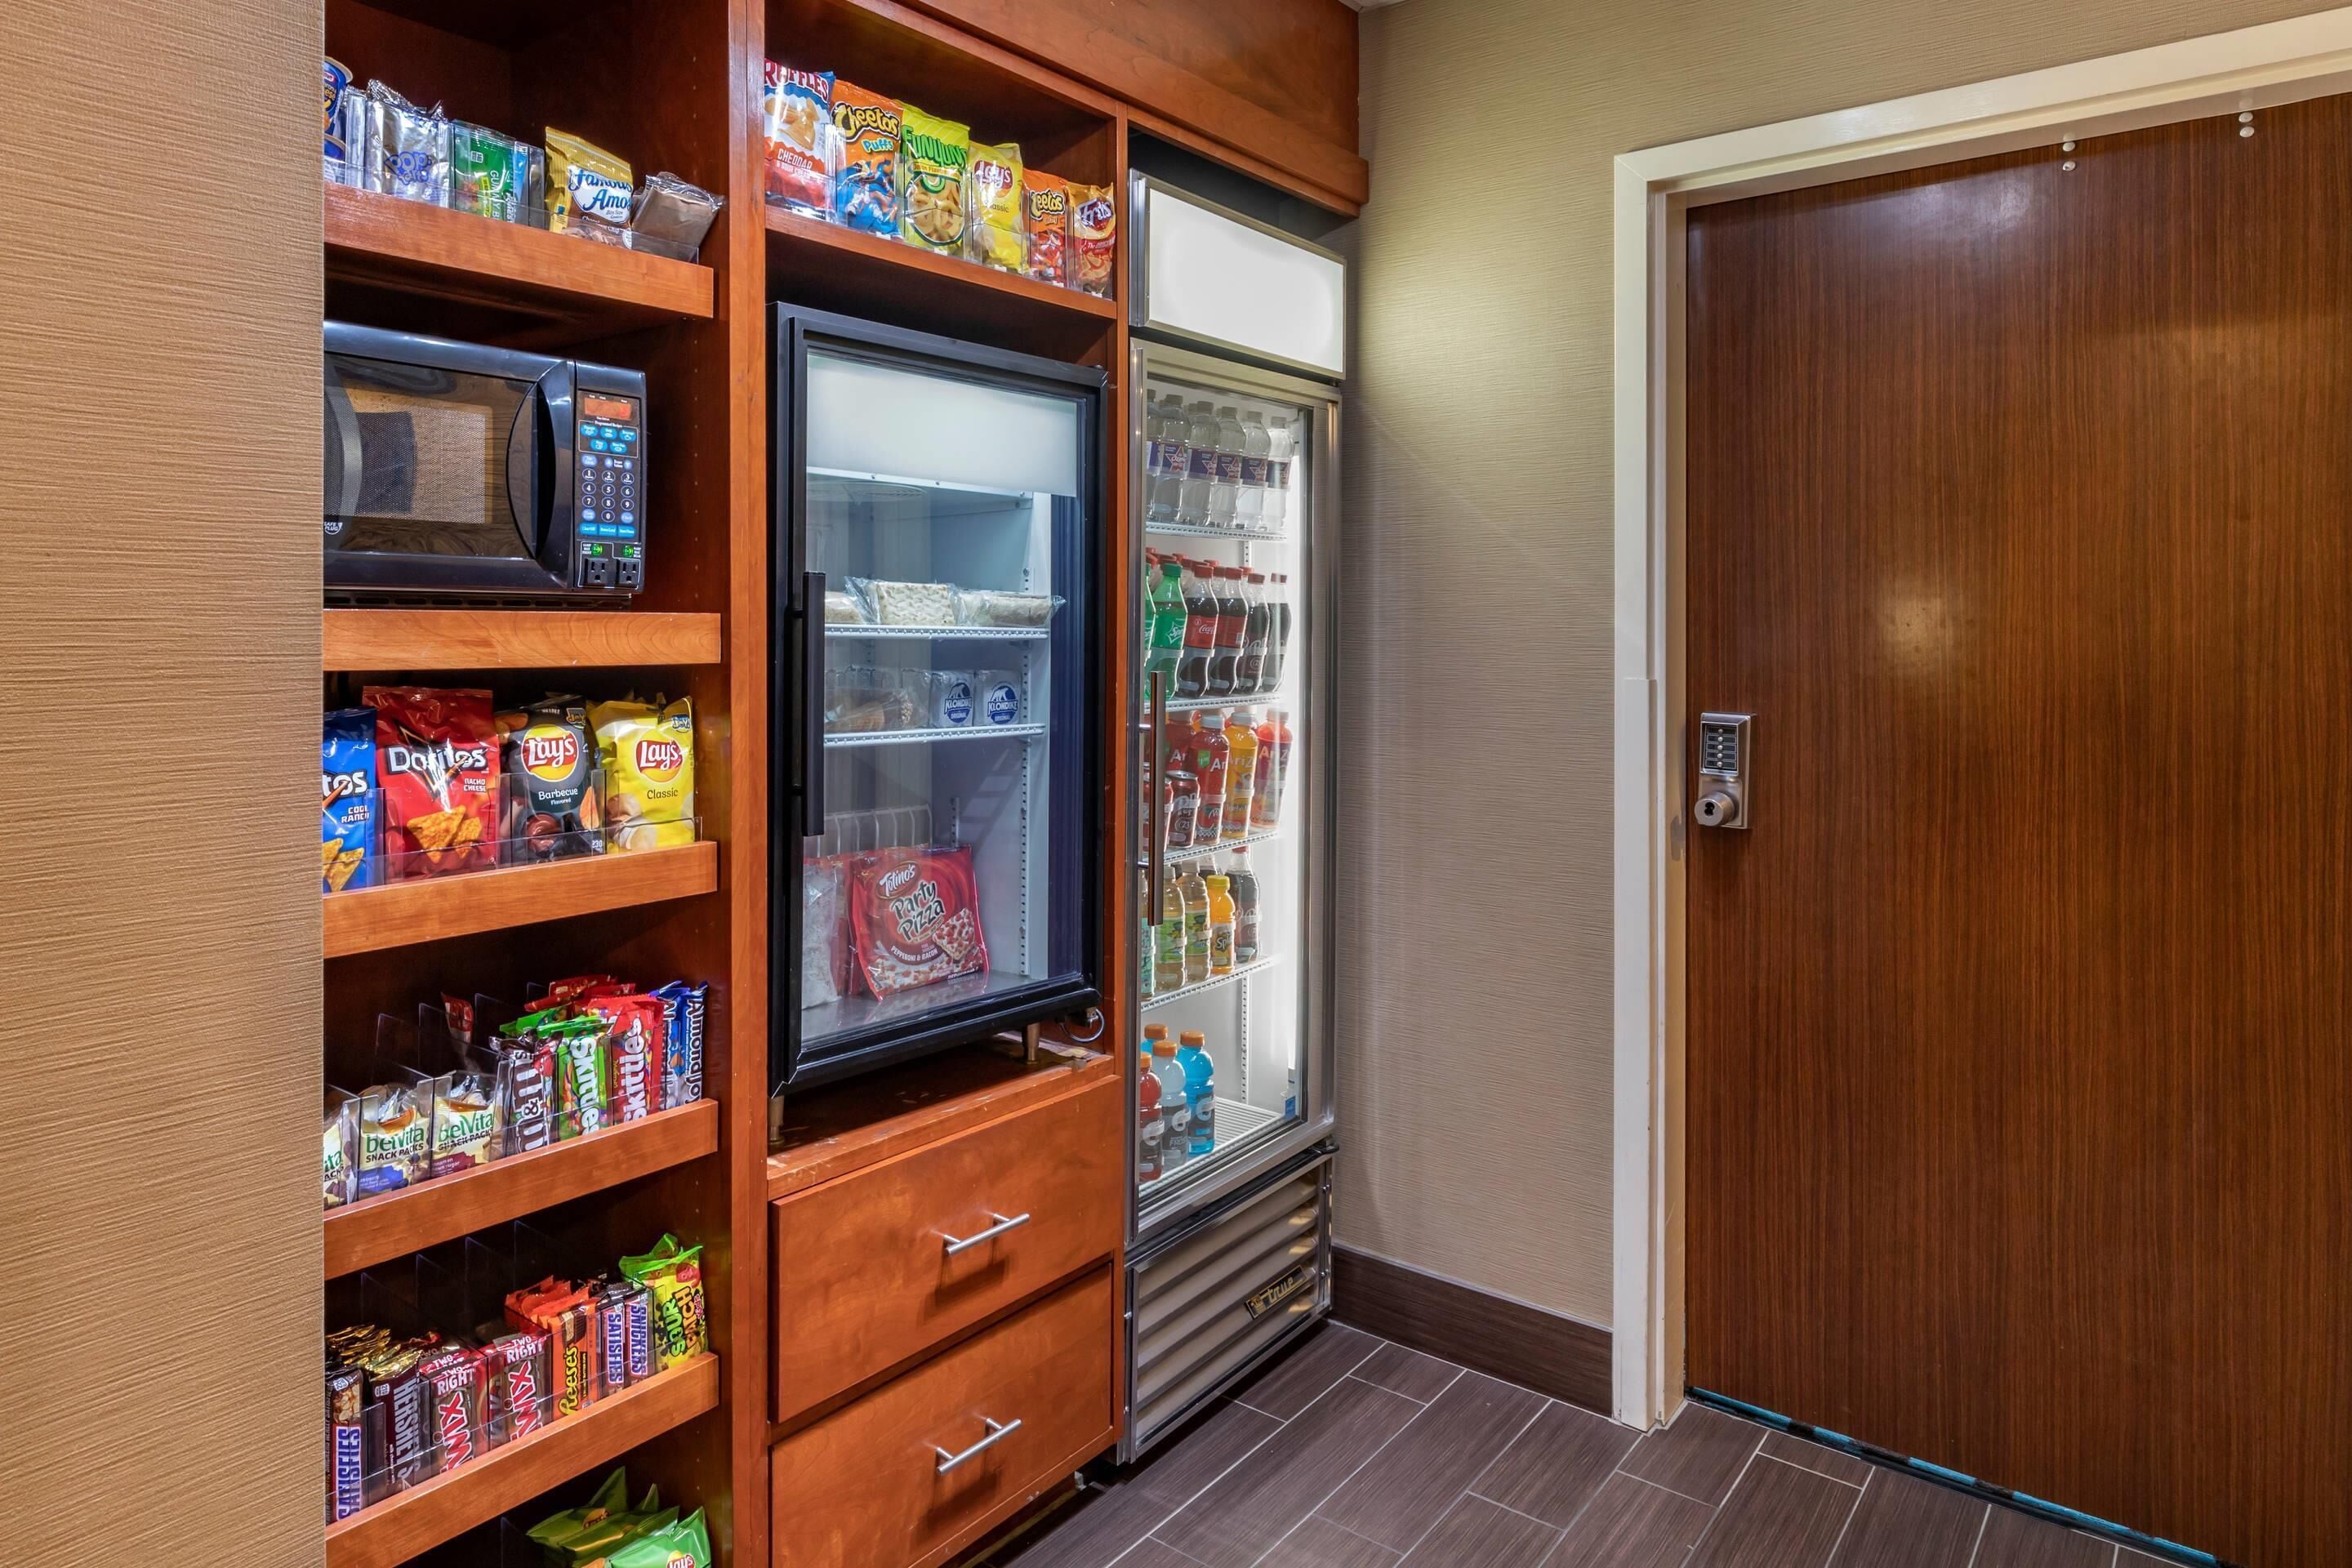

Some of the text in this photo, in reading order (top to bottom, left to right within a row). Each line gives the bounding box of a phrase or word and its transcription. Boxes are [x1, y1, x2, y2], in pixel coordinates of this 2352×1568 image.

[764, 59, 829, 105] RUFFLES
[832, 104, 898, 139] Cheetos
[862, 136, 894, 153] Puffs
[777, 148, 813, 171] CHEDDAR
[568, 168, 633, 192] Famous
[582, 189, 631, 212] Amos
[988, 701, 1018, 716] KLONDIKE
[388, 746, 488, 773] Doritos
[528, 735, 575, 768] Lay's
[640, 738, 681, 771] Lay's
[463, 784, 487, 792] CHEESE
[464, 777, 486, 786] NACHO
[647, 787, 679, 800] Classic
[537, 787, 578, 801] Barbecue
[550, 797, 572, 805] Flavored
[341, 812, 370, 824] RANCH
[347, 805, 369, 814] COOL
[880, 864, 915, 897] Totino's
[893, 882, 936, 920] Party
[899, 898, 944, 942] Pizza
[890, 946, 915, 961] PEPPERONI
[922, 948, 938, 958] BACON
[439, 1112, 493, 1143] belVita
[366, 1128, 425, 1153] belVita
[366, 1143, 424, 1163] SNACK PACKS
[662, 1298, 686, 1357] SOUR
[674, 1286, 697, 1350] PATCH
[511, 1336, 532, 1347] TWO
[608, 1312, 623, 1383] SATISFIES
[630, 1304, 648, 1374] SNICKERS
[433, 1355, 453, 1370] TWO
[506, 1341, 543, 1364] RIGHT
[437, 1367, 474, 1396] RIGHT
[559, 1345, 579, 1414] Reese's
[337, 1428, 360, 1519] SATISFIES
